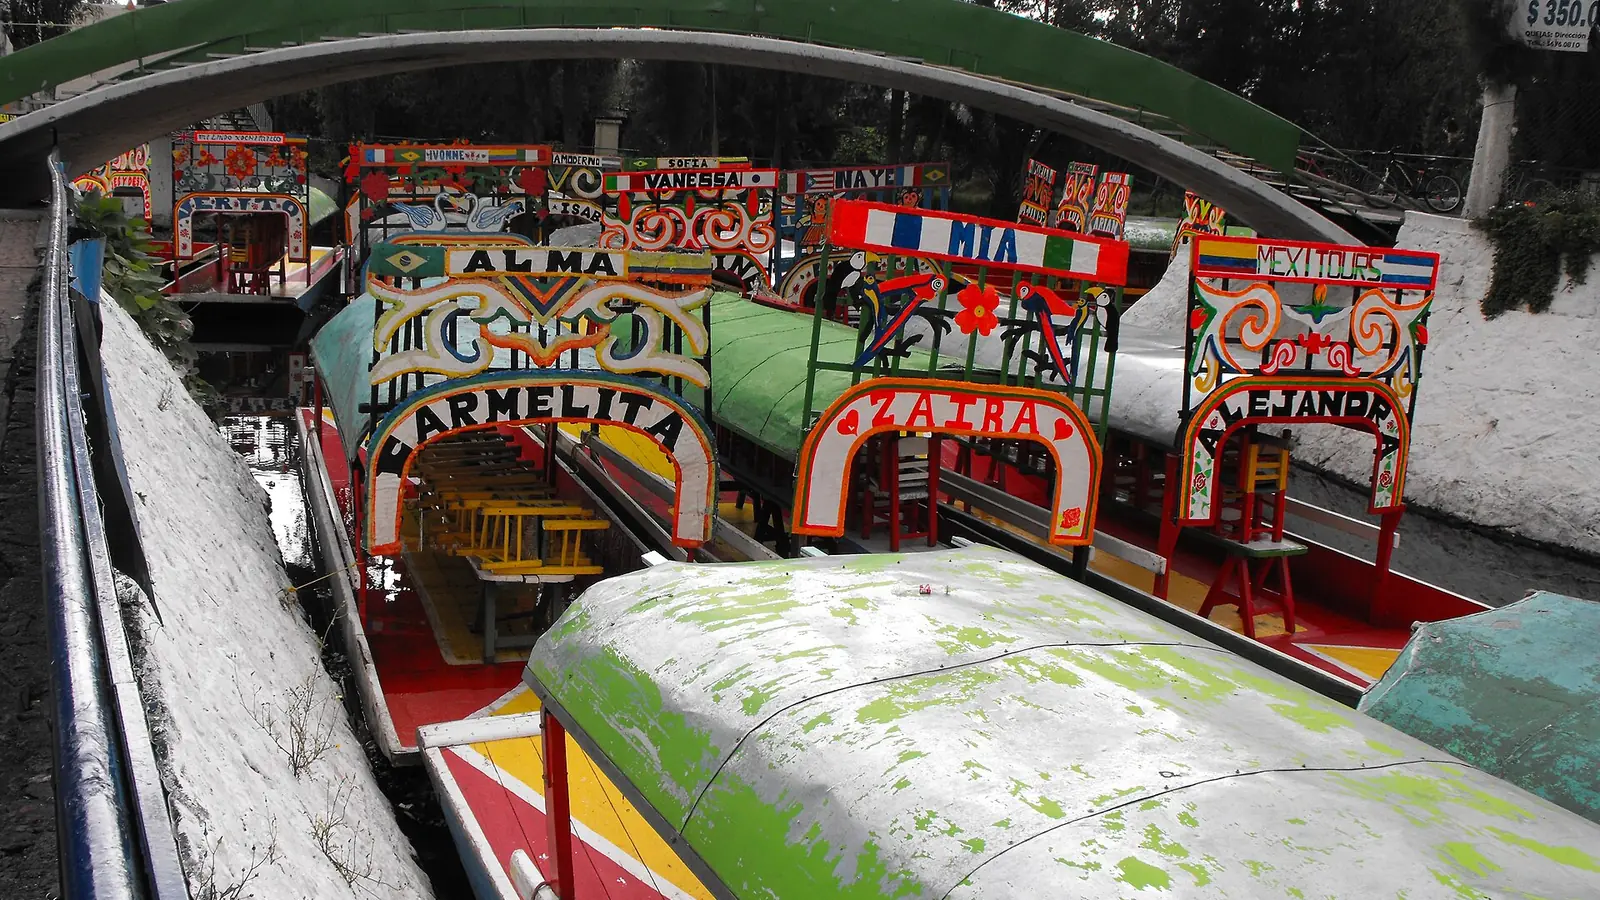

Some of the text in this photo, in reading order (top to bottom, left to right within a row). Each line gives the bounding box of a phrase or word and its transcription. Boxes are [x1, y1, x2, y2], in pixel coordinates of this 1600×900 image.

[429, 150, 465, 160] IVONNE
[668, 159, 708, 168] SOFIA
[645, 172, 741, 189] VANESSA
[949, 219, 1018, 263] MIA
[463, 250, 617, 276] ALMA
[1257, 245, 1383, 280] MEXITOURS
[375, 384, 684, 477] CARMELITA
[870, 391, 1040, 435] ZAIRA
[1200, 390, 1400, 462] ALEJANDRA
